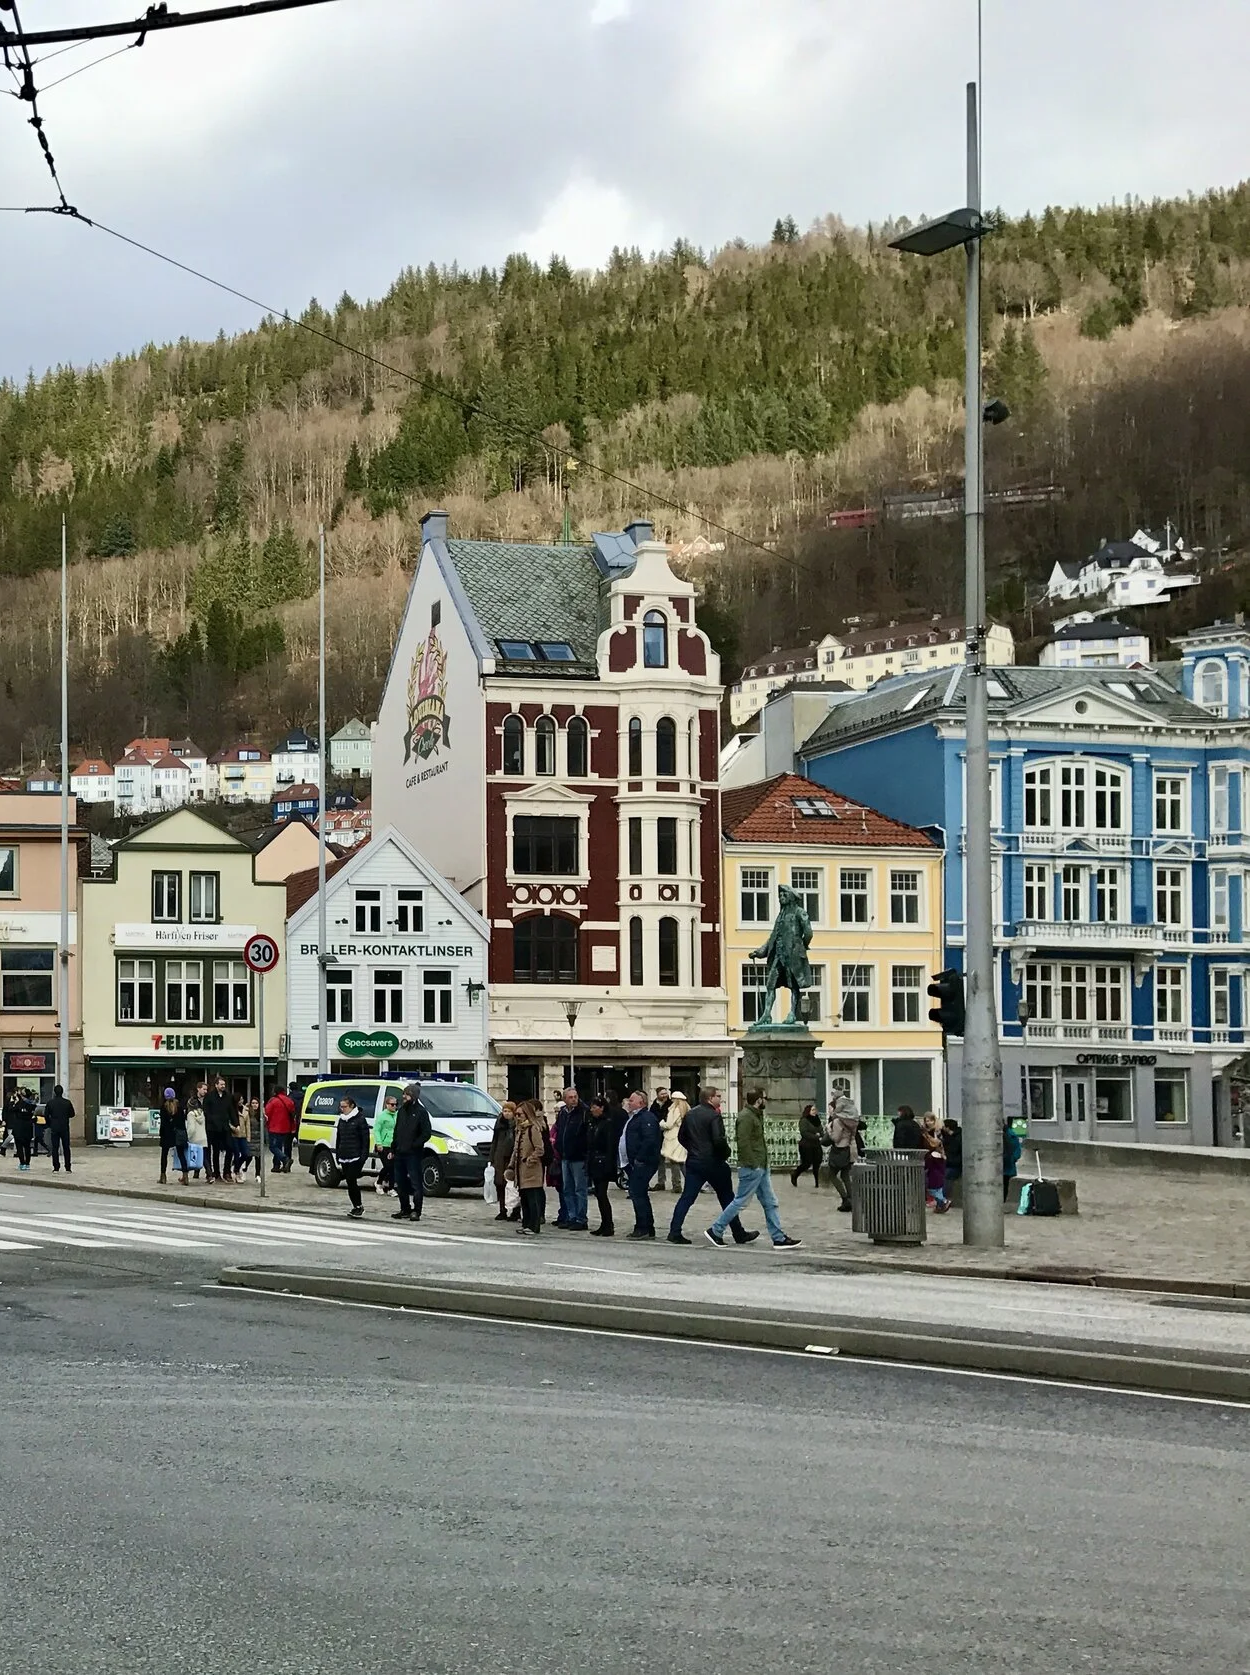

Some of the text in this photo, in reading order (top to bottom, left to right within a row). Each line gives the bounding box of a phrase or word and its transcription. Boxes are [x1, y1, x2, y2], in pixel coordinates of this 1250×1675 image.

[421, 761, 449, 781] RESTAURANT
[251, 944, 273, 963] 30
[300, 944, 473, 957] BRLER-KONTAKTLINSER
[344, 1038, 434, 1051] Specsavers Optikk
